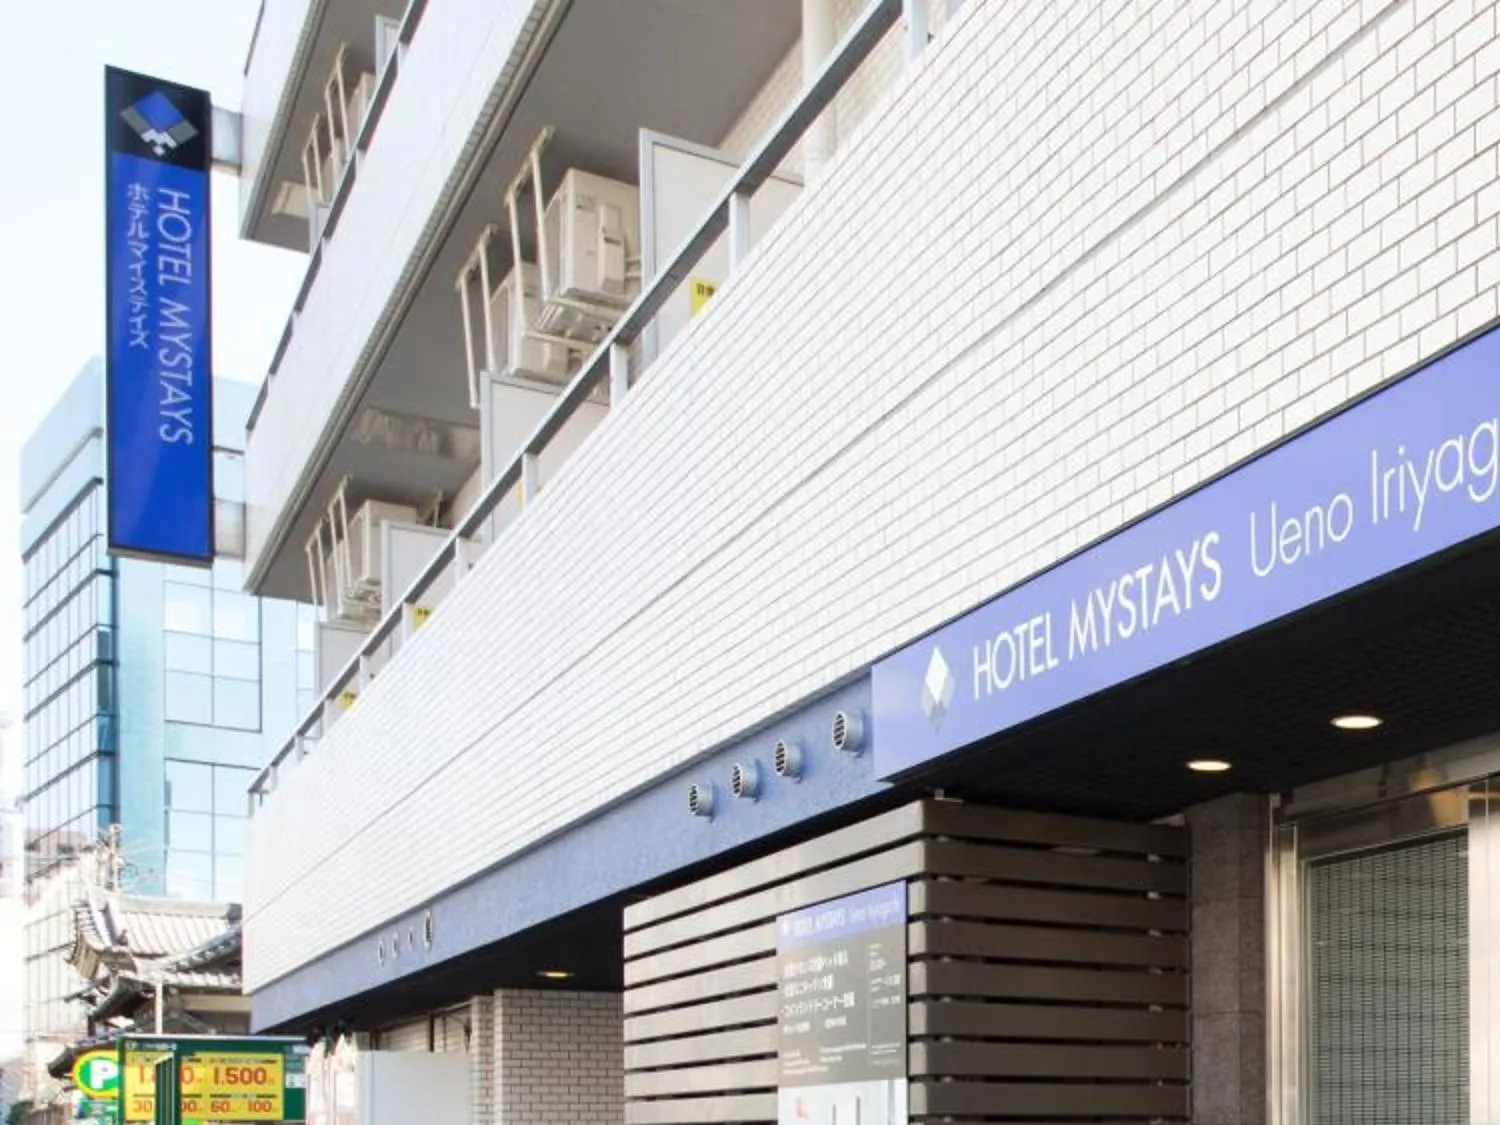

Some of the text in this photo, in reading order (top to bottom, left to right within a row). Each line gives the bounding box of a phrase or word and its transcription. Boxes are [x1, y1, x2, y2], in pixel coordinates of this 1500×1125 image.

[157, 187, 194, 445] HOTEL MYSTAYS
[973, 611, 1059, 700] HOTEL
[1068, 531, 1222, 661] MYSTAYS
[1250, 493, 1353, 577] Ueno
